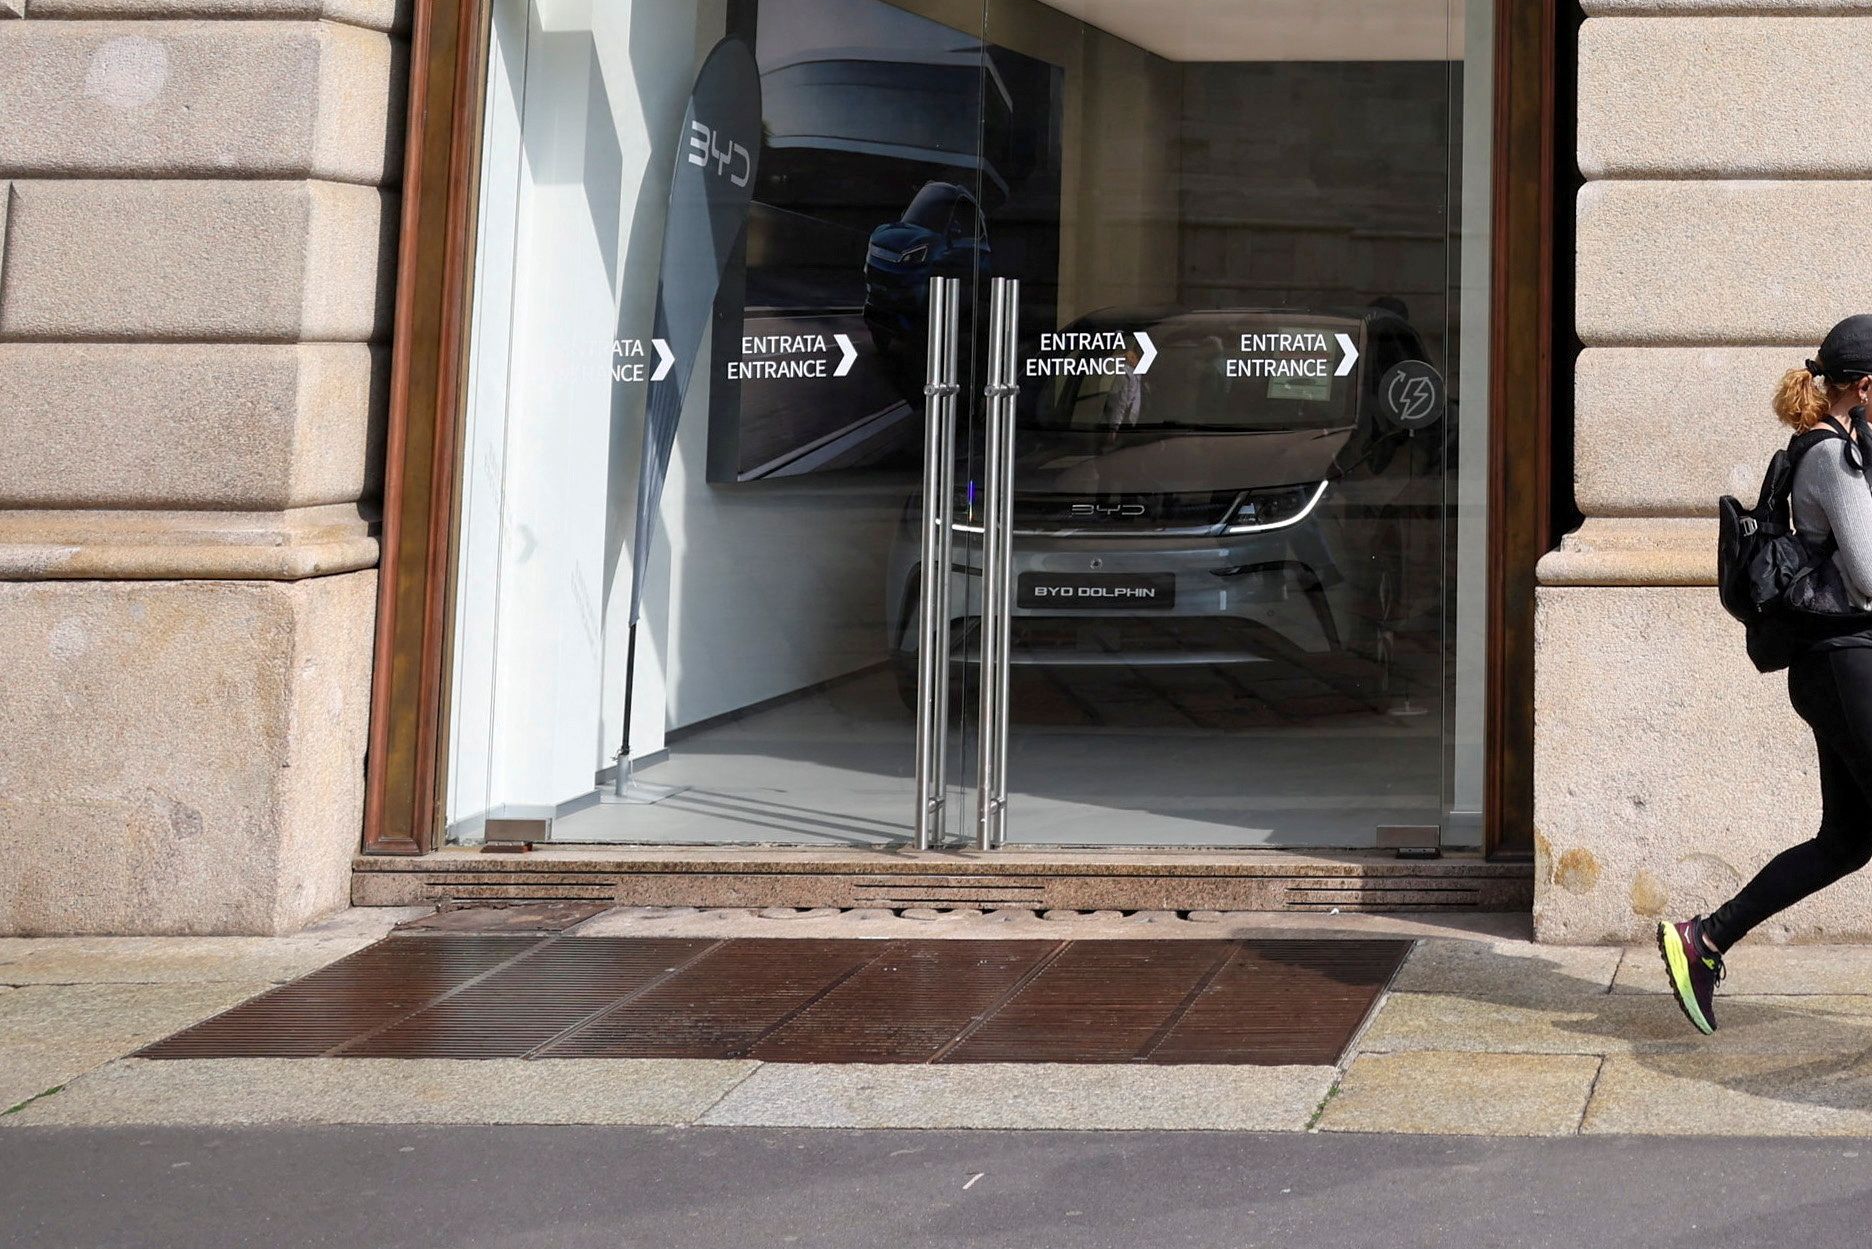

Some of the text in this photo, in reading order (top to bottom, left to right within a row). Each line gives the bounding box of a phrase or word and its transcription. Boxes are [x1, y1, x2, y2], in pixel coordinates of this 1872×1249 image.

[688, 120, 750, 187] BYD
[742, 335, 827, 354] ENTRATA
[1040, 332, 1126, 351] ENTRATA
[1240, 333, 1327, 352] ENTRATA
[727, 360, 827, 380] ENTRANCE
[1026, 357, 1126, 377] ENTRANCE
[1226, 358, 1327, 377] ENTRANCE
[1071, 504, 1146, 516] BYD
[1034, 587, 1155, 598] BYD DOLPHIN
